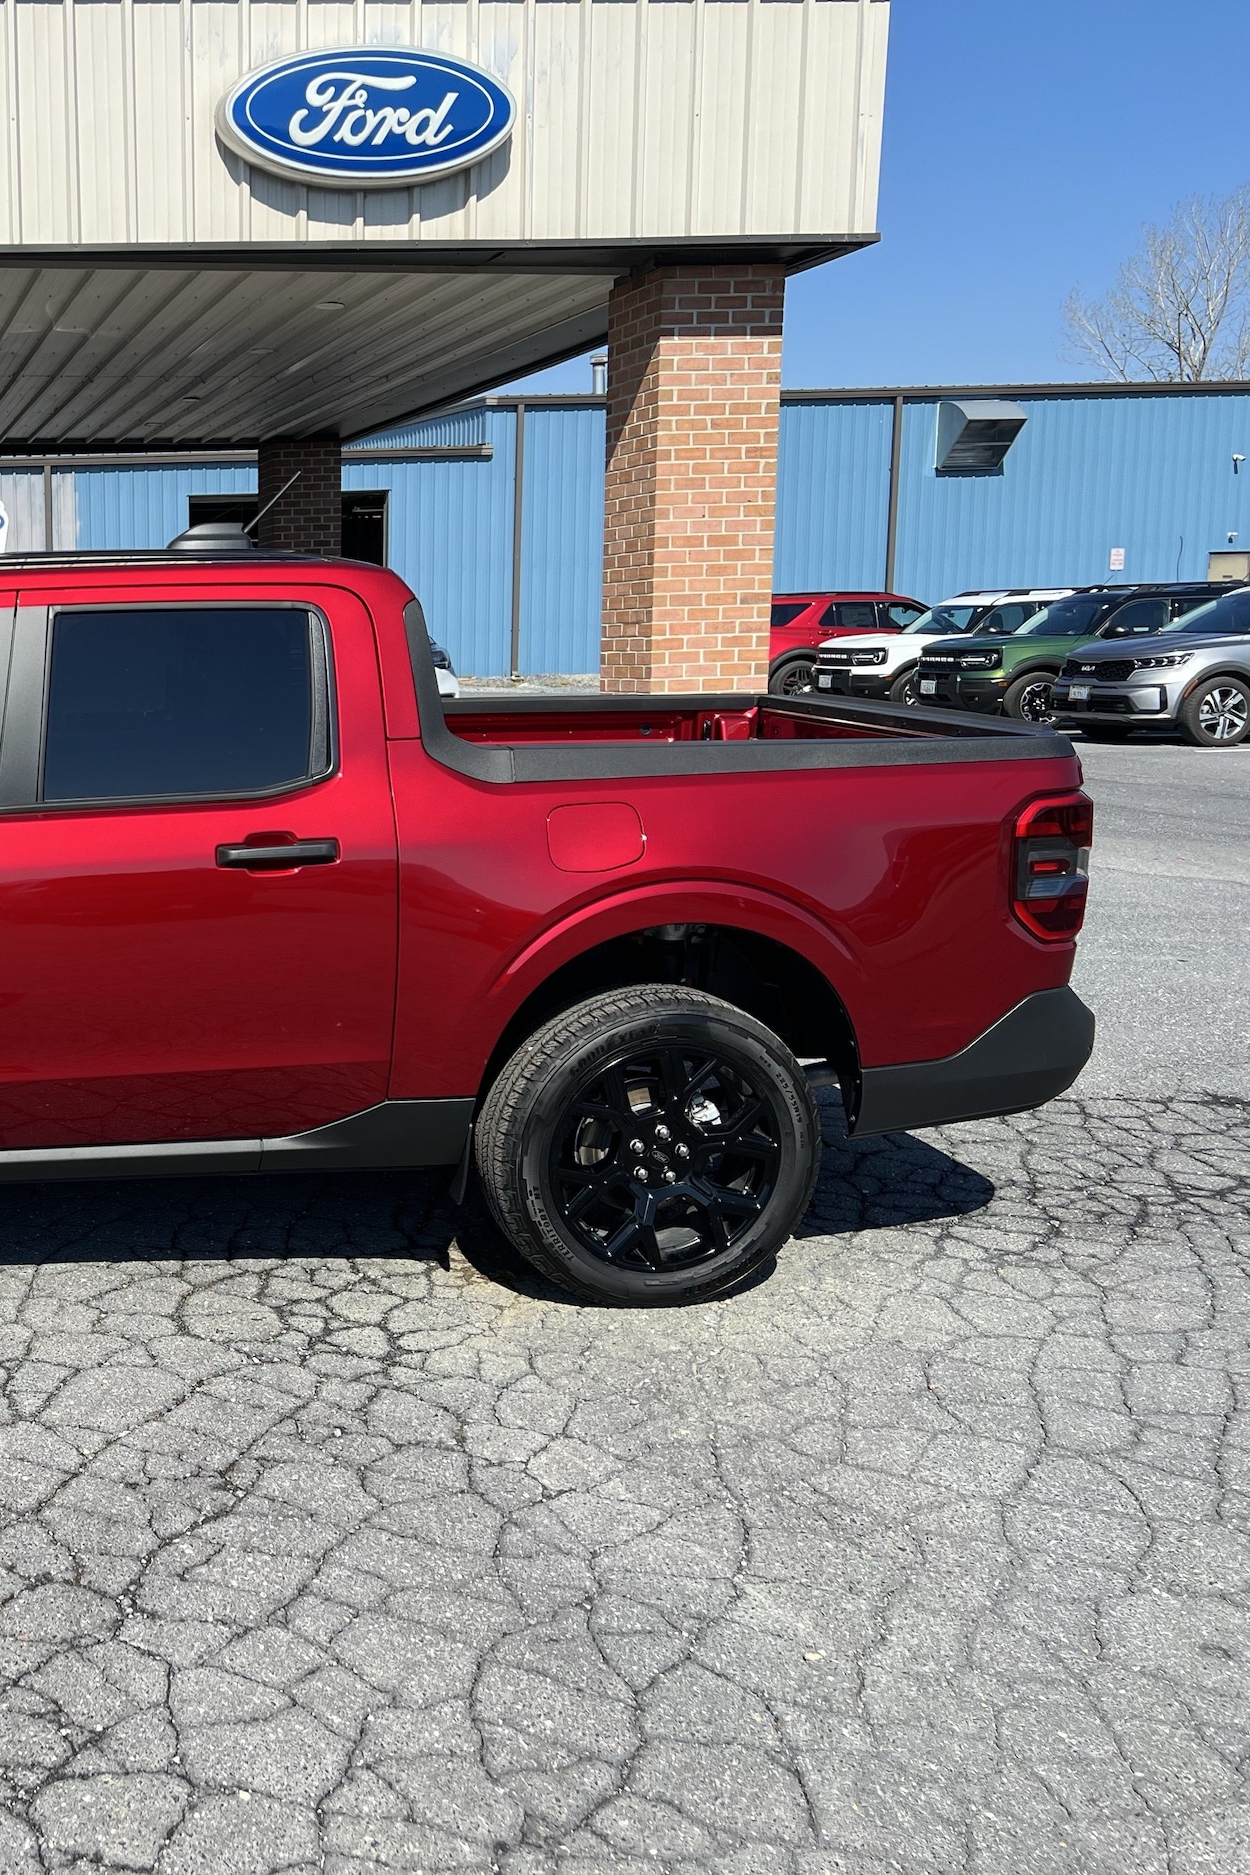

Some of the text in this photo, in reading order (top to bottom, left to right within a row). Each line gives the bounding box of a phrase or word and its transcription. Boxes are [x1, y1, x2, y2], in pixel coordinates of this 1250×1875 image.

[288, 71, 460, 147] Ford
[775, 1071, 803, 1123] 225/55R19
[536, 1208, 575, 1262] TERRITORY
